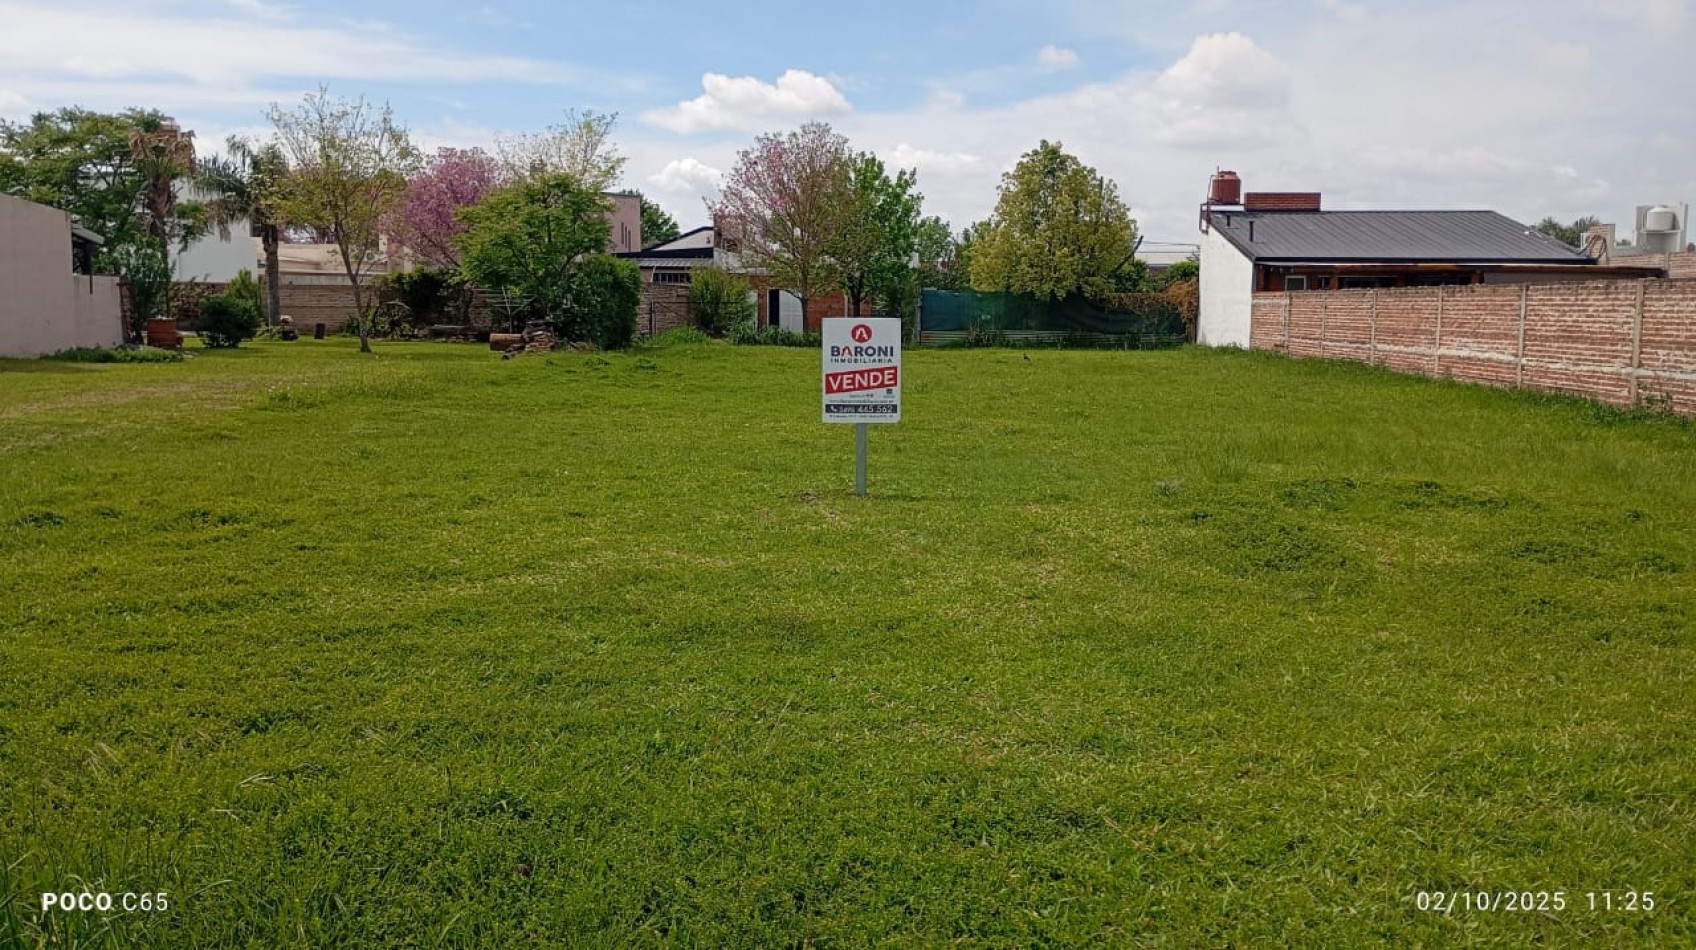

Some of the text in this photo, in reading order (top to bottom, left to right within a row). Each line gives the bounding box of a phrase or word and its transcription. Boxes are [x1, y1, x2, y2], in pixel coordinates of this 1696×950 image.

[831, 345, 894, 357] BARONI
[828, 369, 896, 391] VENDE
[876, 405, 893, 413] 562
